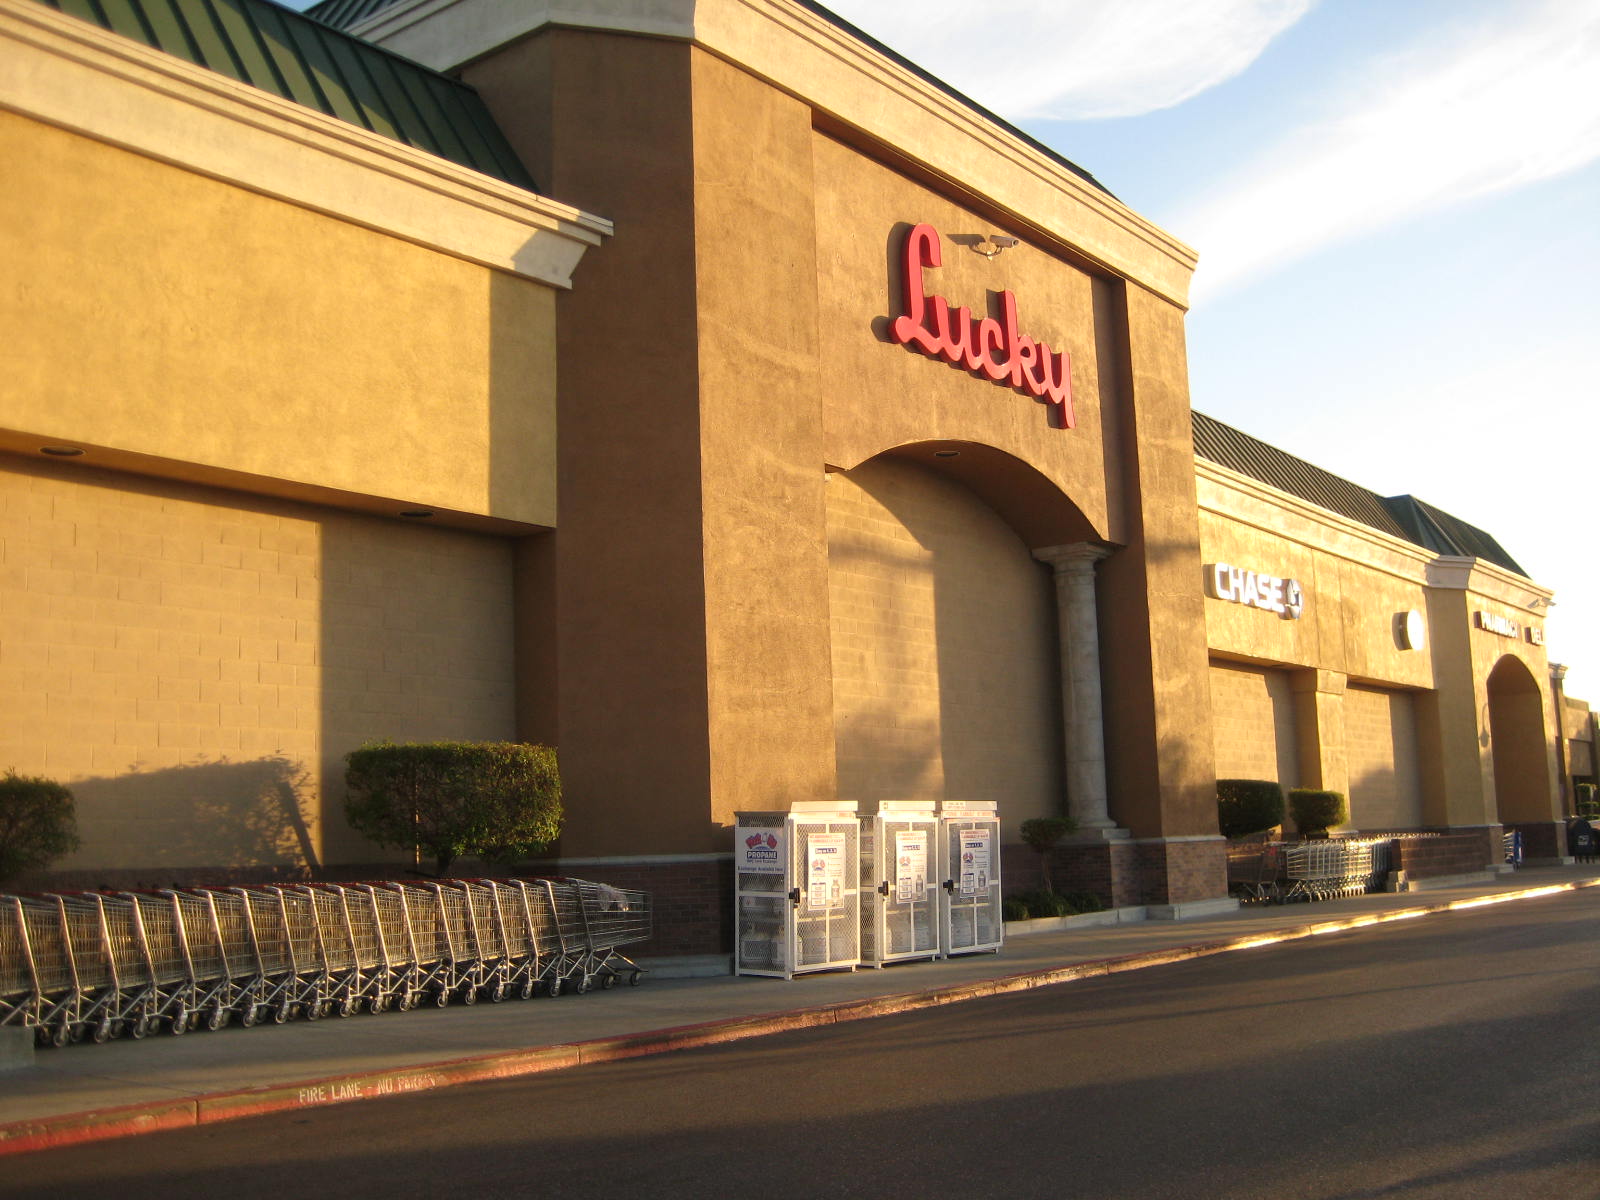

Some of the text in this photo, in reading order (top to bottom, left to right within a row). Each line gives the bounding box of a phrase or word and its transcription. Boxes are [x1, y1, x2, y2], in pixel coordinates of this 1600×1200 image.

[891, 222, 1077, 429] Lucky
[1214, 562, 1285, 613] CHASE
[747, 851, 777, 859] PROPANE
[299, 1085, 327, 1103] FIRE
[330, 1080, 363, 1100] LANE
[377, 1079, 394, 1095] NO
